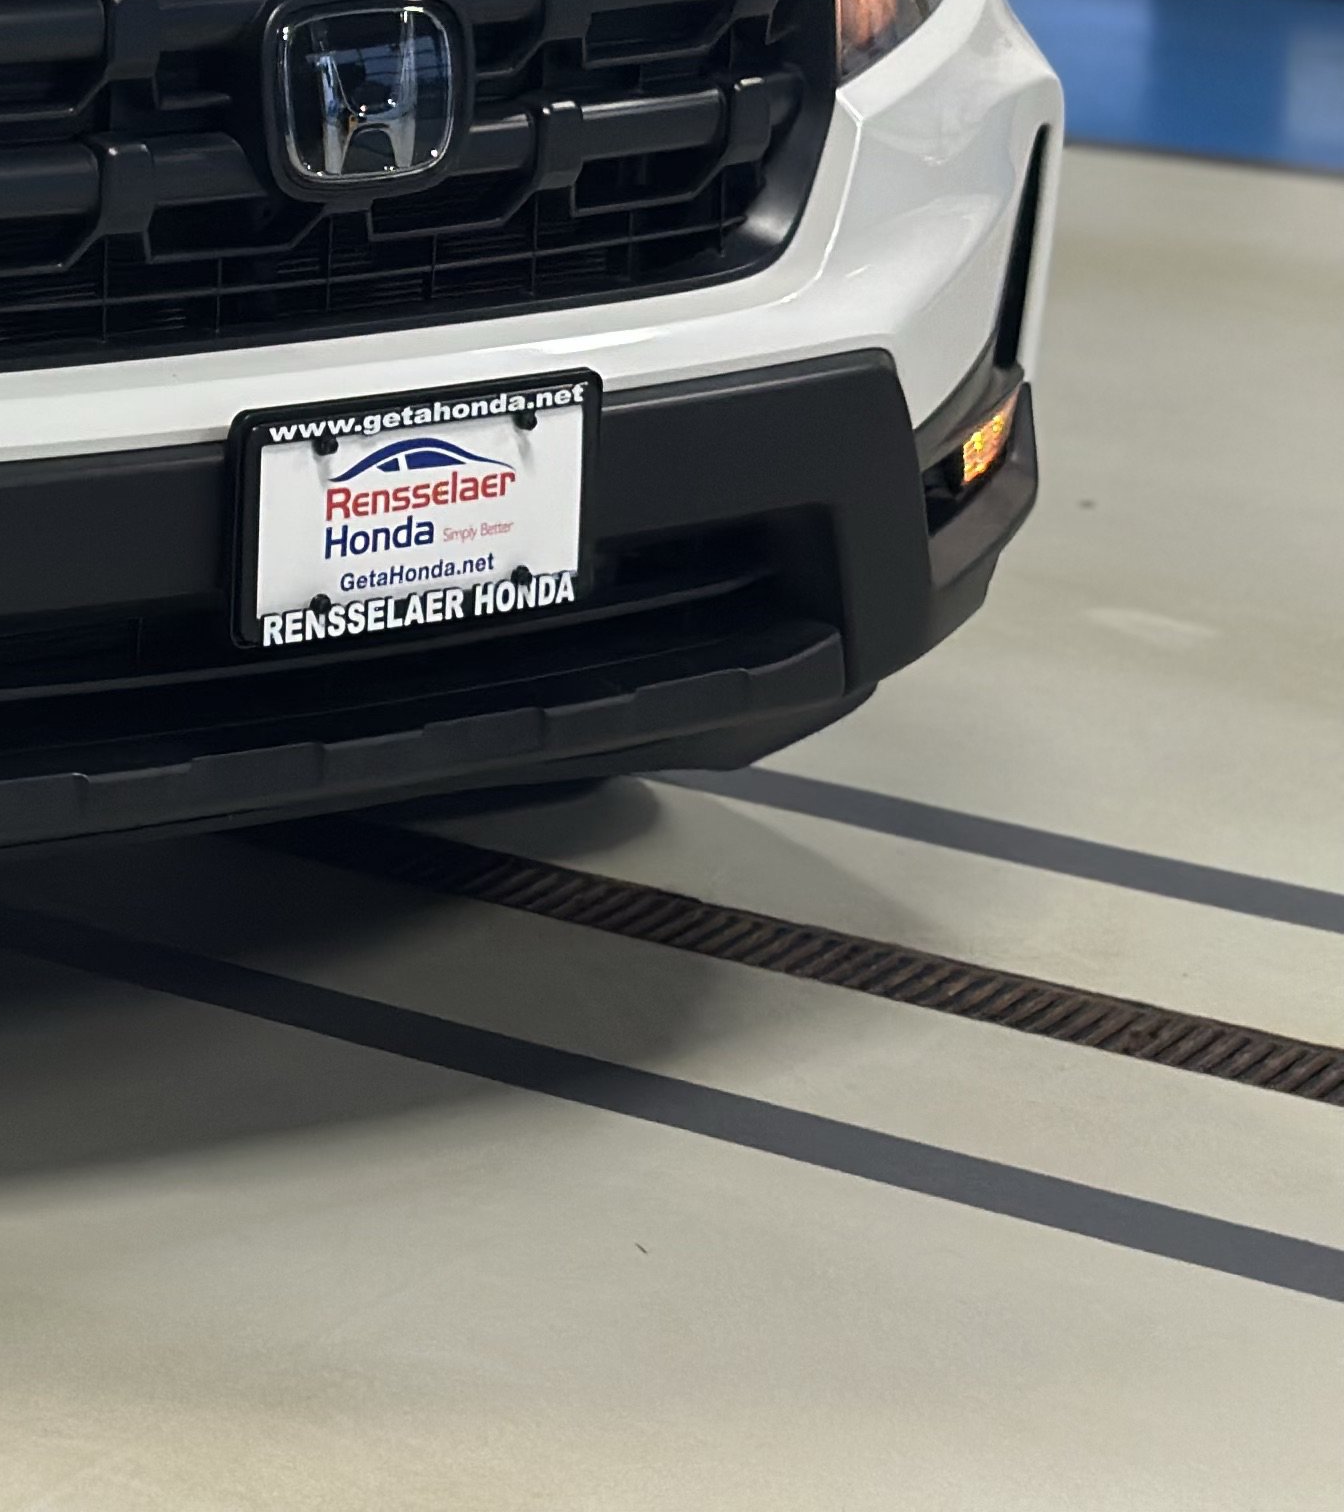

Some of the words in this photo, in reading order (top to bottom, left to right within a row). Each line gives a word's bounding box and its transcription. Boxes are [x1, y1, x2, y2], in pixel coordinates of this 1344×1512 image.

[269, 383, 585, 442] www.getahonda.net
[326, 471, 516, 521] Rensselaer
[324, 516, 435, 560] Honda
[442, 525, 478, 543] Simply
[479, 521, 515, 538] Better
[340, 553, 495, 592] GetaHonda.net
[262, 589, 464, 647] RENSSELAER
[473, 571, 575, 616] HONDA
